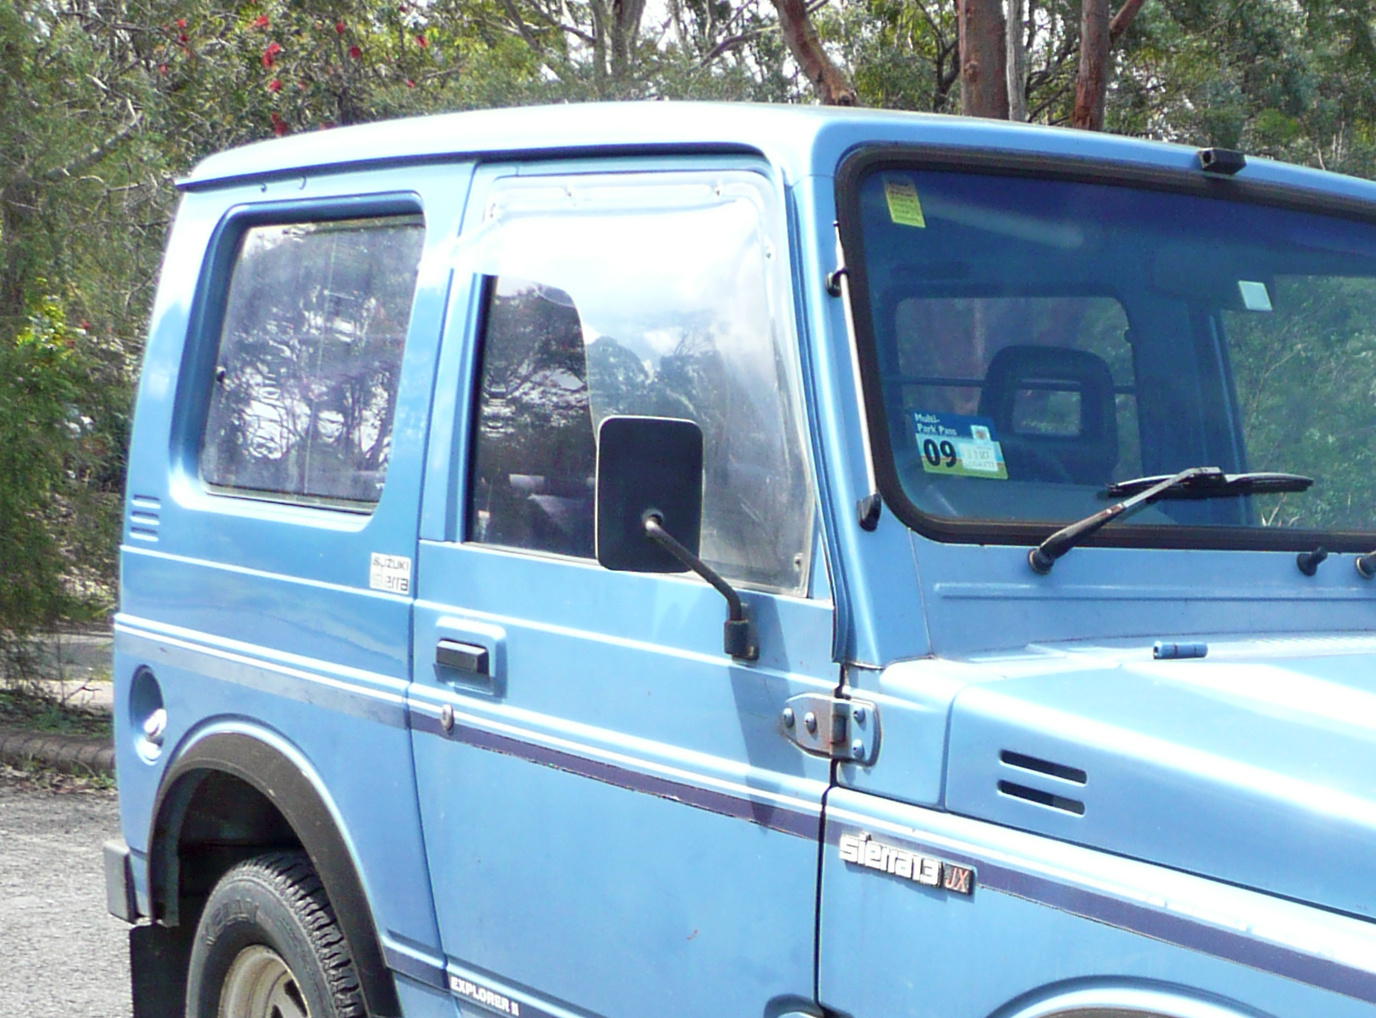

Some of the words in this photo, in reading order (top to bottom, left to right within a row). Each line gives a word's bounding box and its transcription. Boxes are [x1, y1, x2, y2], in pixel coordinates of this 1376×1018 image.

[917, 423, 937, 433] Park
[938, 425, 958, 436] Pass
[923, 438, 957, 468] 09
[373, 556, 410, 571] SUZUKI
[450, 976, 511, 1012] EXPLORER
